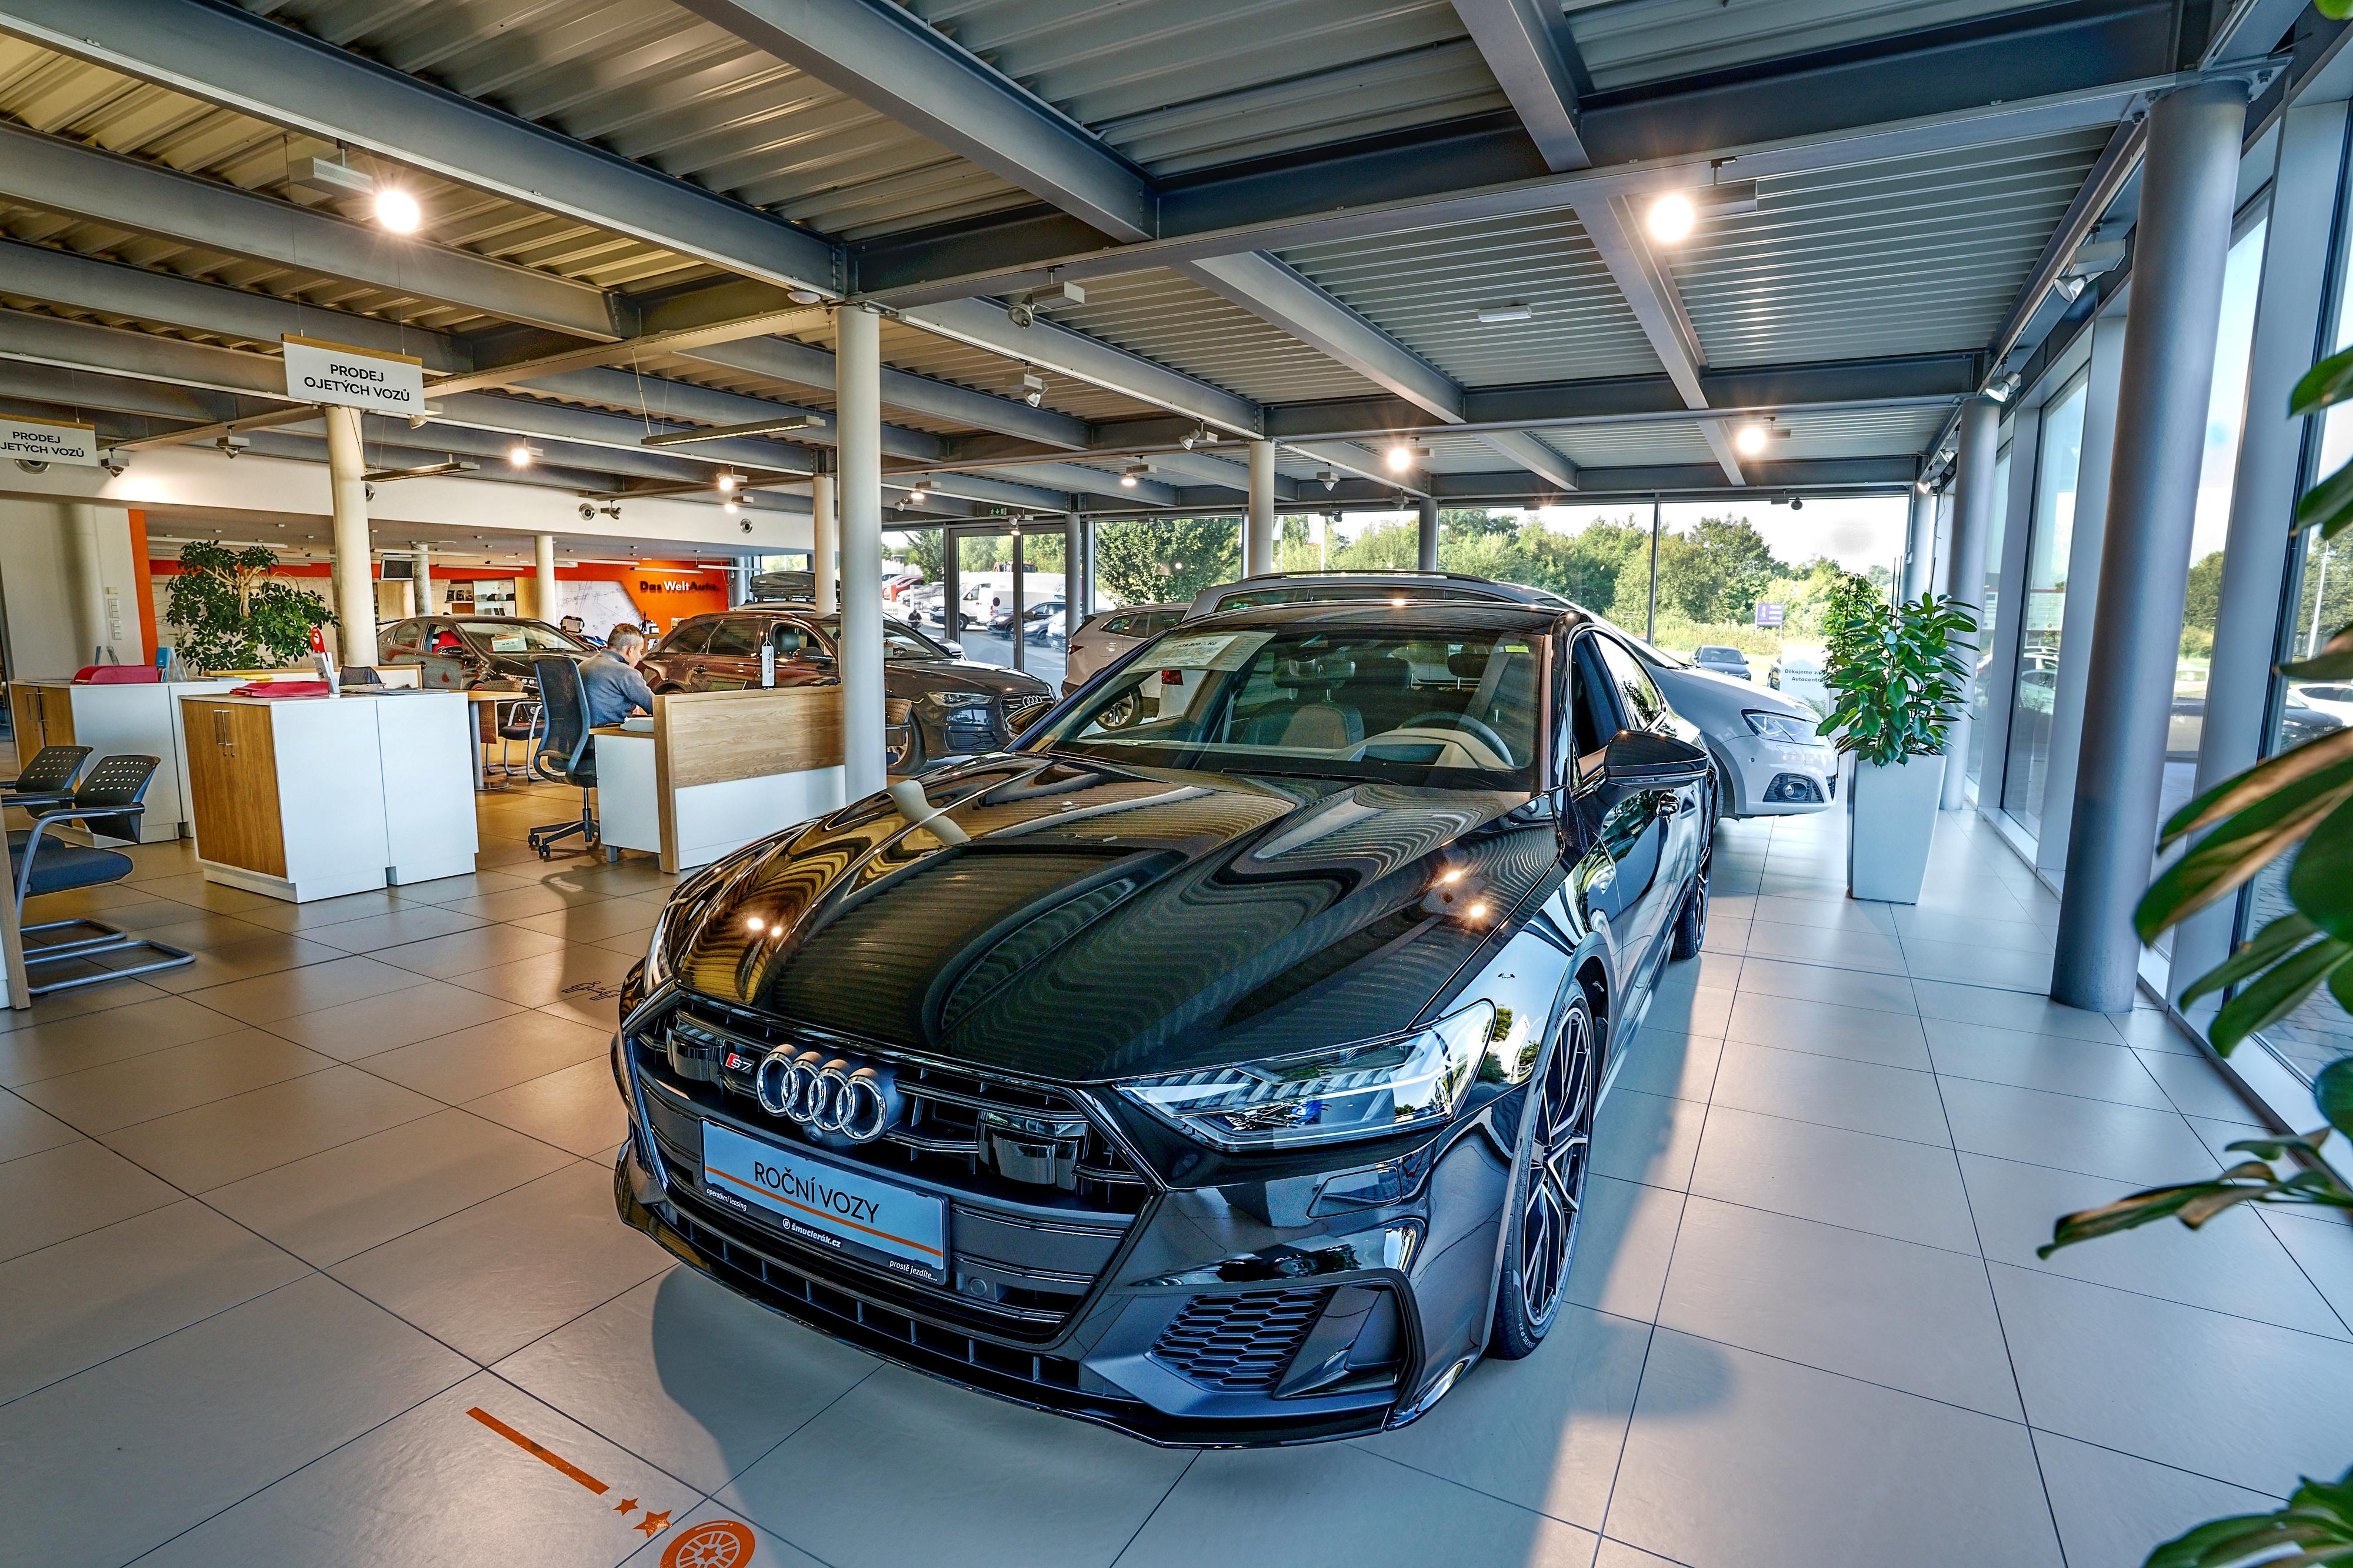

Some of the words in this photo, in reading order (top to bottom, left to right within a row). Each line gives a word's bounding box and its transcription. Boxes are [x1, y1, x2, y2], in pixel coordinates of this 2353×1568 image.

[330, 363, 384, 382] PRODEJ
[304, 376, 369, 396] OJETÝCH
[373, 387, 410, 402] VOZŮ
[12, 431, 61, 443] PRODEJ
[0, 442, 48, 453] JETÝCH
[51, 446, 84, 458] VOZŮ
[640, 581, 662, 590] Das
[731, 1057, 752, 1071] S7
[706, 1189, 730, 1202] operativní
[729, 1197, 747, 1212] leasing
[755, 1161, 815, 1203] ROČNÍ
[818, 1185, 879, 1223] VOZY
[791, 1223, 841, 1247] šmuclerák.cz
[889, 1260, 909, 1272] prostě
[909, 1266, 938, 1282] jezdíte...
